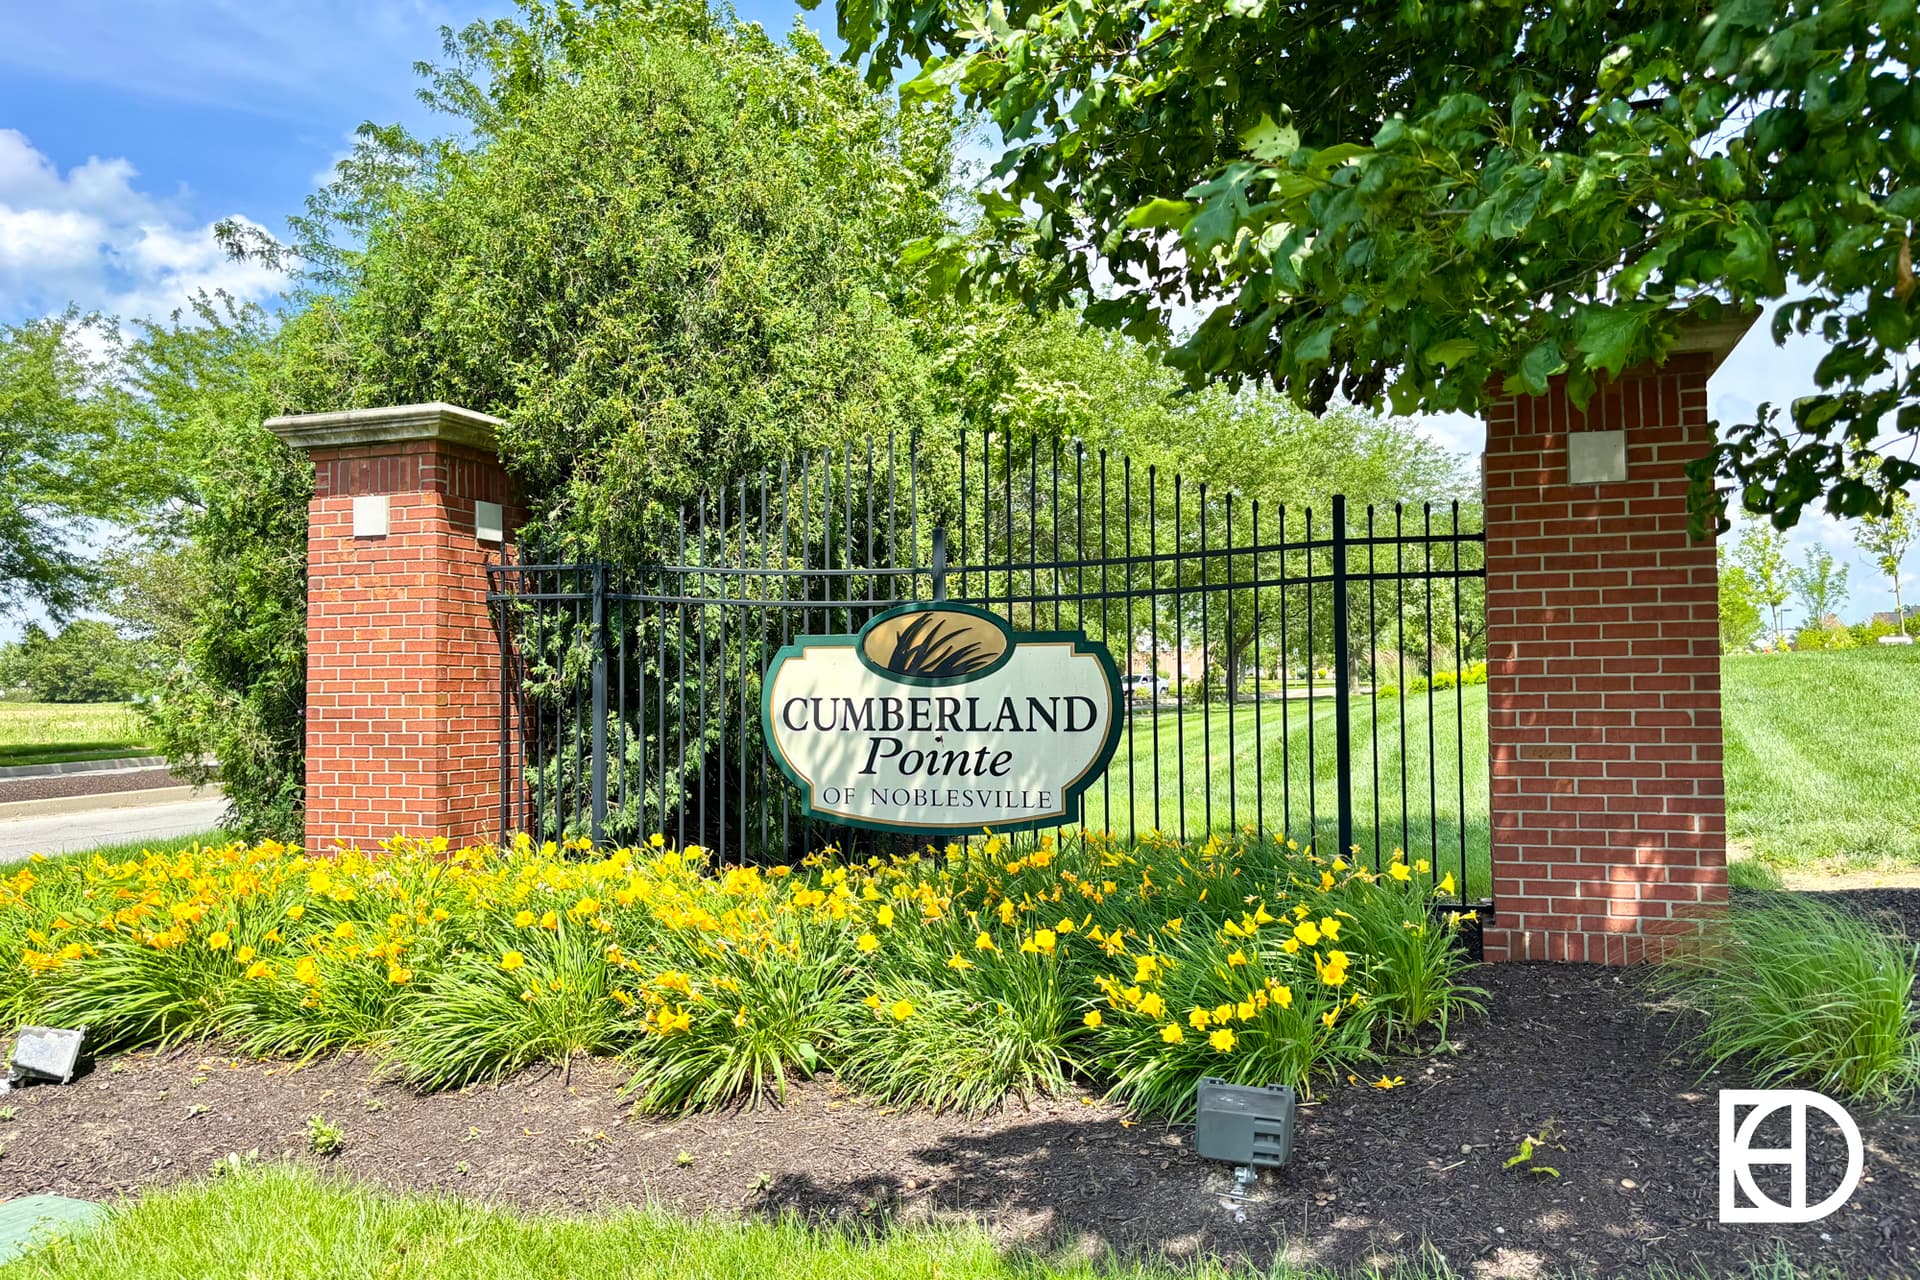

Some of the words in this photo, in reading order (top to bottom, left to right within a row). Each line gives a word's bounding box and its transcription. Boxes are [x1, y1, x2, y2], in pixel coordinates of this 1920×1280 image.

[782, 696, 1098, 733] CUMBERLAND
[858, 736, 1013, 777] Pointe
[822, 786, 856, 805] OF
[871, 787, 1052, 809] NOBLESVILLE
